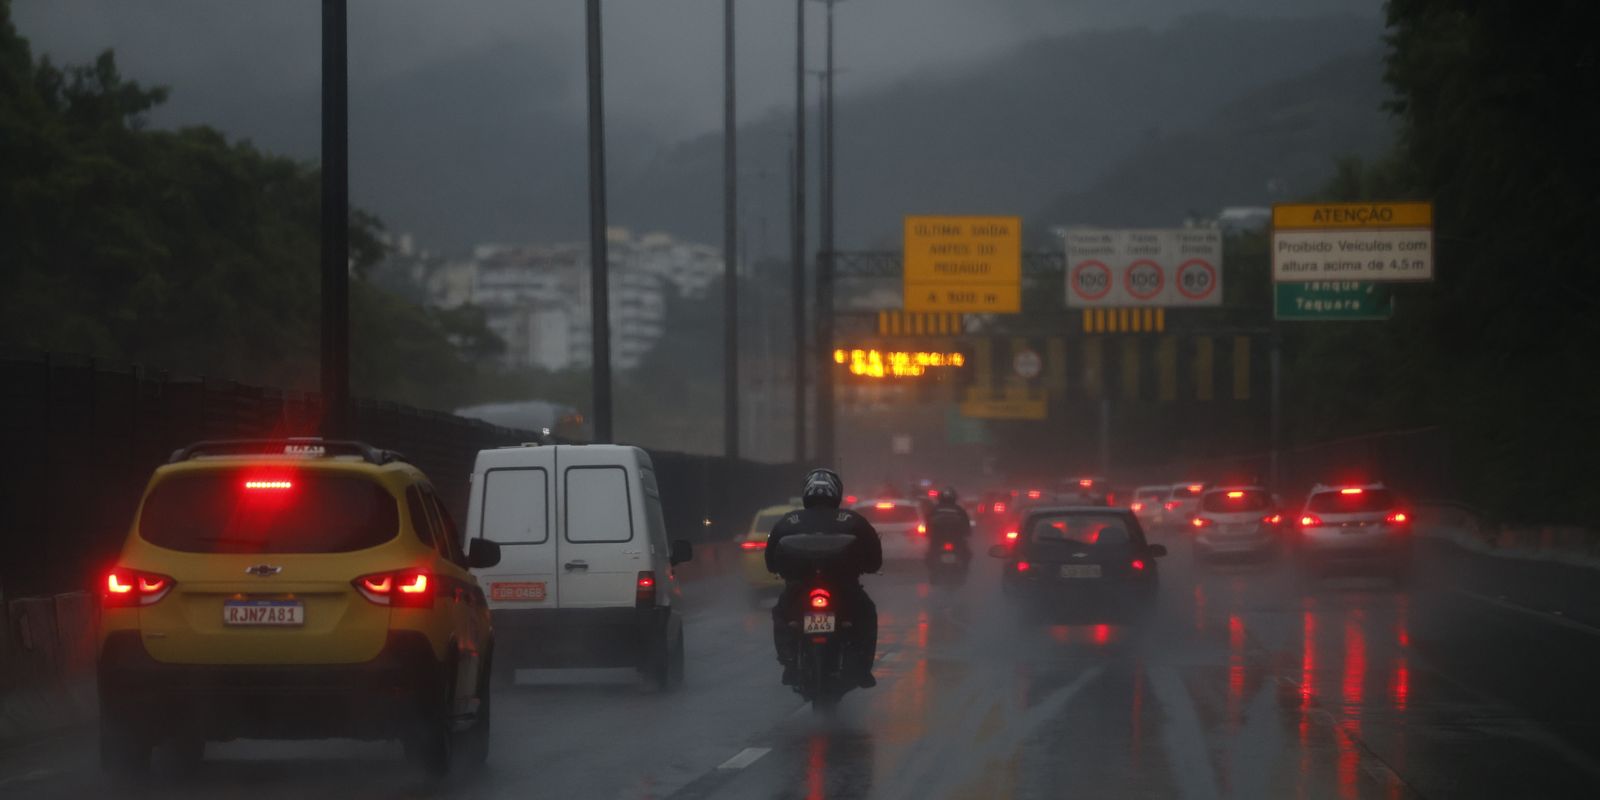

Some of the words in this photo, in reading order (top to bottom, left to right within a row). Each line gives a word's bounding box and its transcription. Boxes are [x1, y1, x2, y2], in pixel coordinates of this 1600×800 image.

[1312, 207, 1393, 223] ATENÇÃO
[1278, 240, 1333, 253] Proibido
[1398, 241, 1428, 251] com
[1281, 260, 1318, 272] altura
[1323, 261, 1362, 272] acima
[1368, 259, 1384, 271] de
[1081, 272, 1107, 287] 100
[1132, 272, 1158, 287] 100
[1296, 297, 1360, 311] Taquara
[230, 607, 295, 622] RJN7A81
